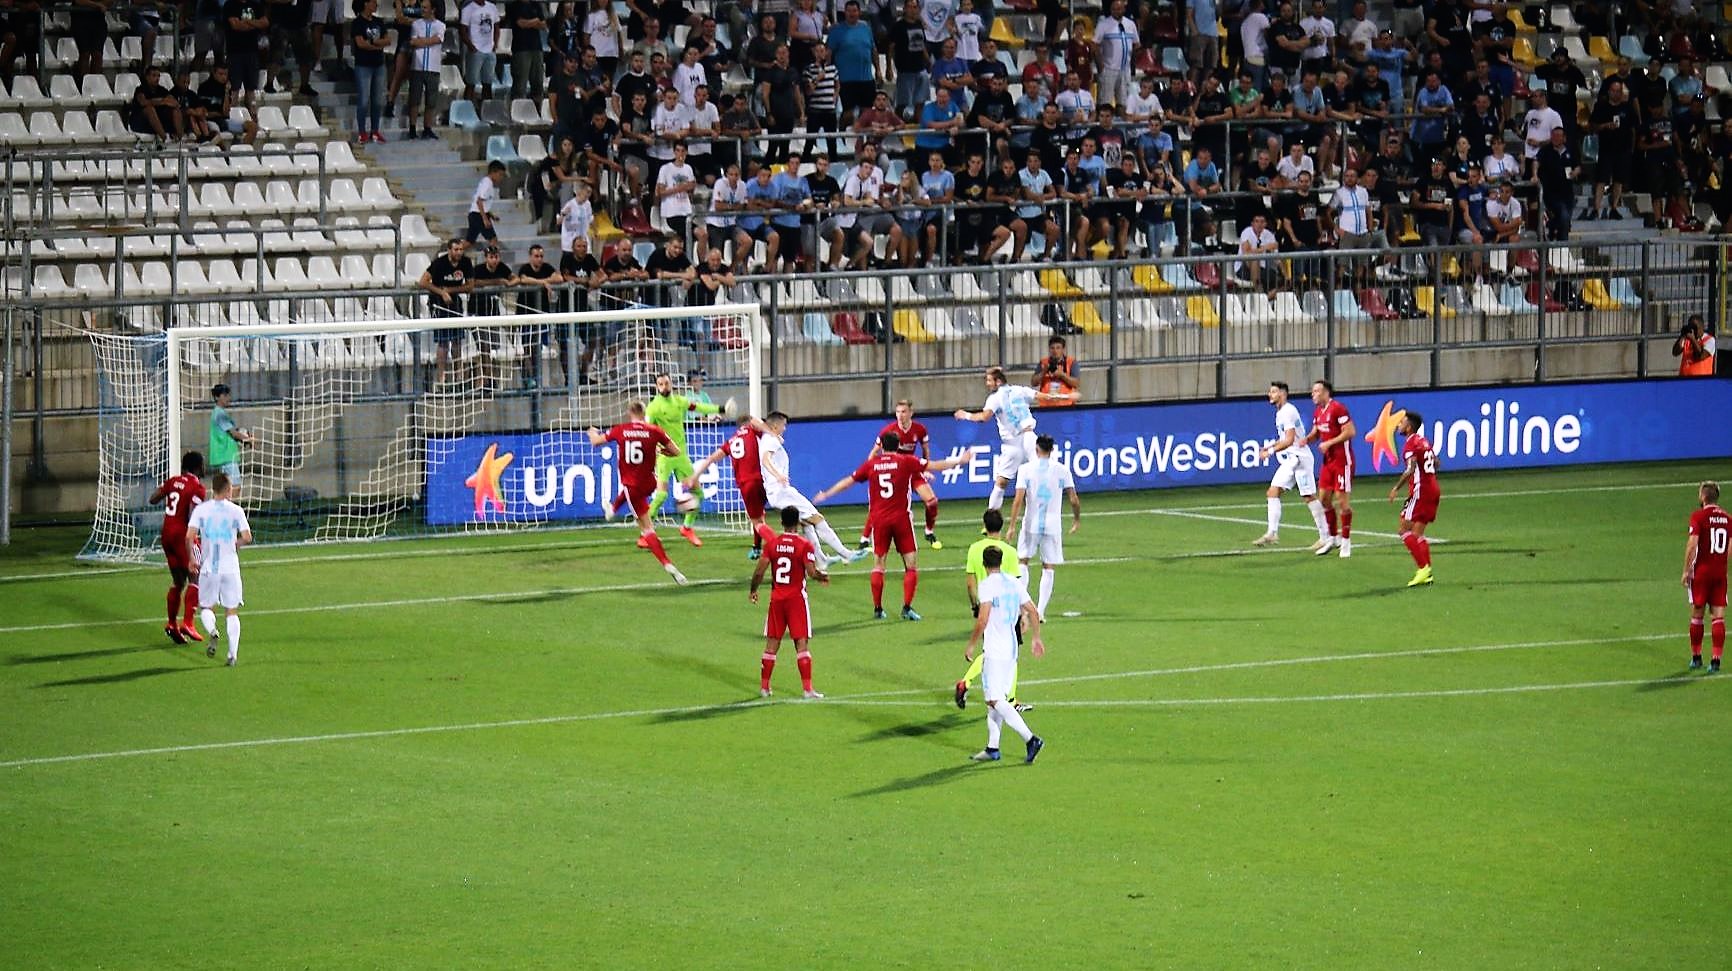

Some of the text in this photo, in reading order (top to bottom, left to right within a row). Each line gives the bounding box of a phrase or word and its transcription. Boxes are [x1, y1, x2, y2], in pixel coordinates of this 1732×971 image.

[624, 440, 644, 464] 16
[730, 437, 745, 459] 9
[941, 431, 1290, 485] #EtionsWeShar
[525, 446, 720, 506] unie
[878, 473, 894, 499] 5
[165, 491, 180, 516] 3
[1710, 527, 1728, 554] 10
[775, 556, 792, 584] 2
